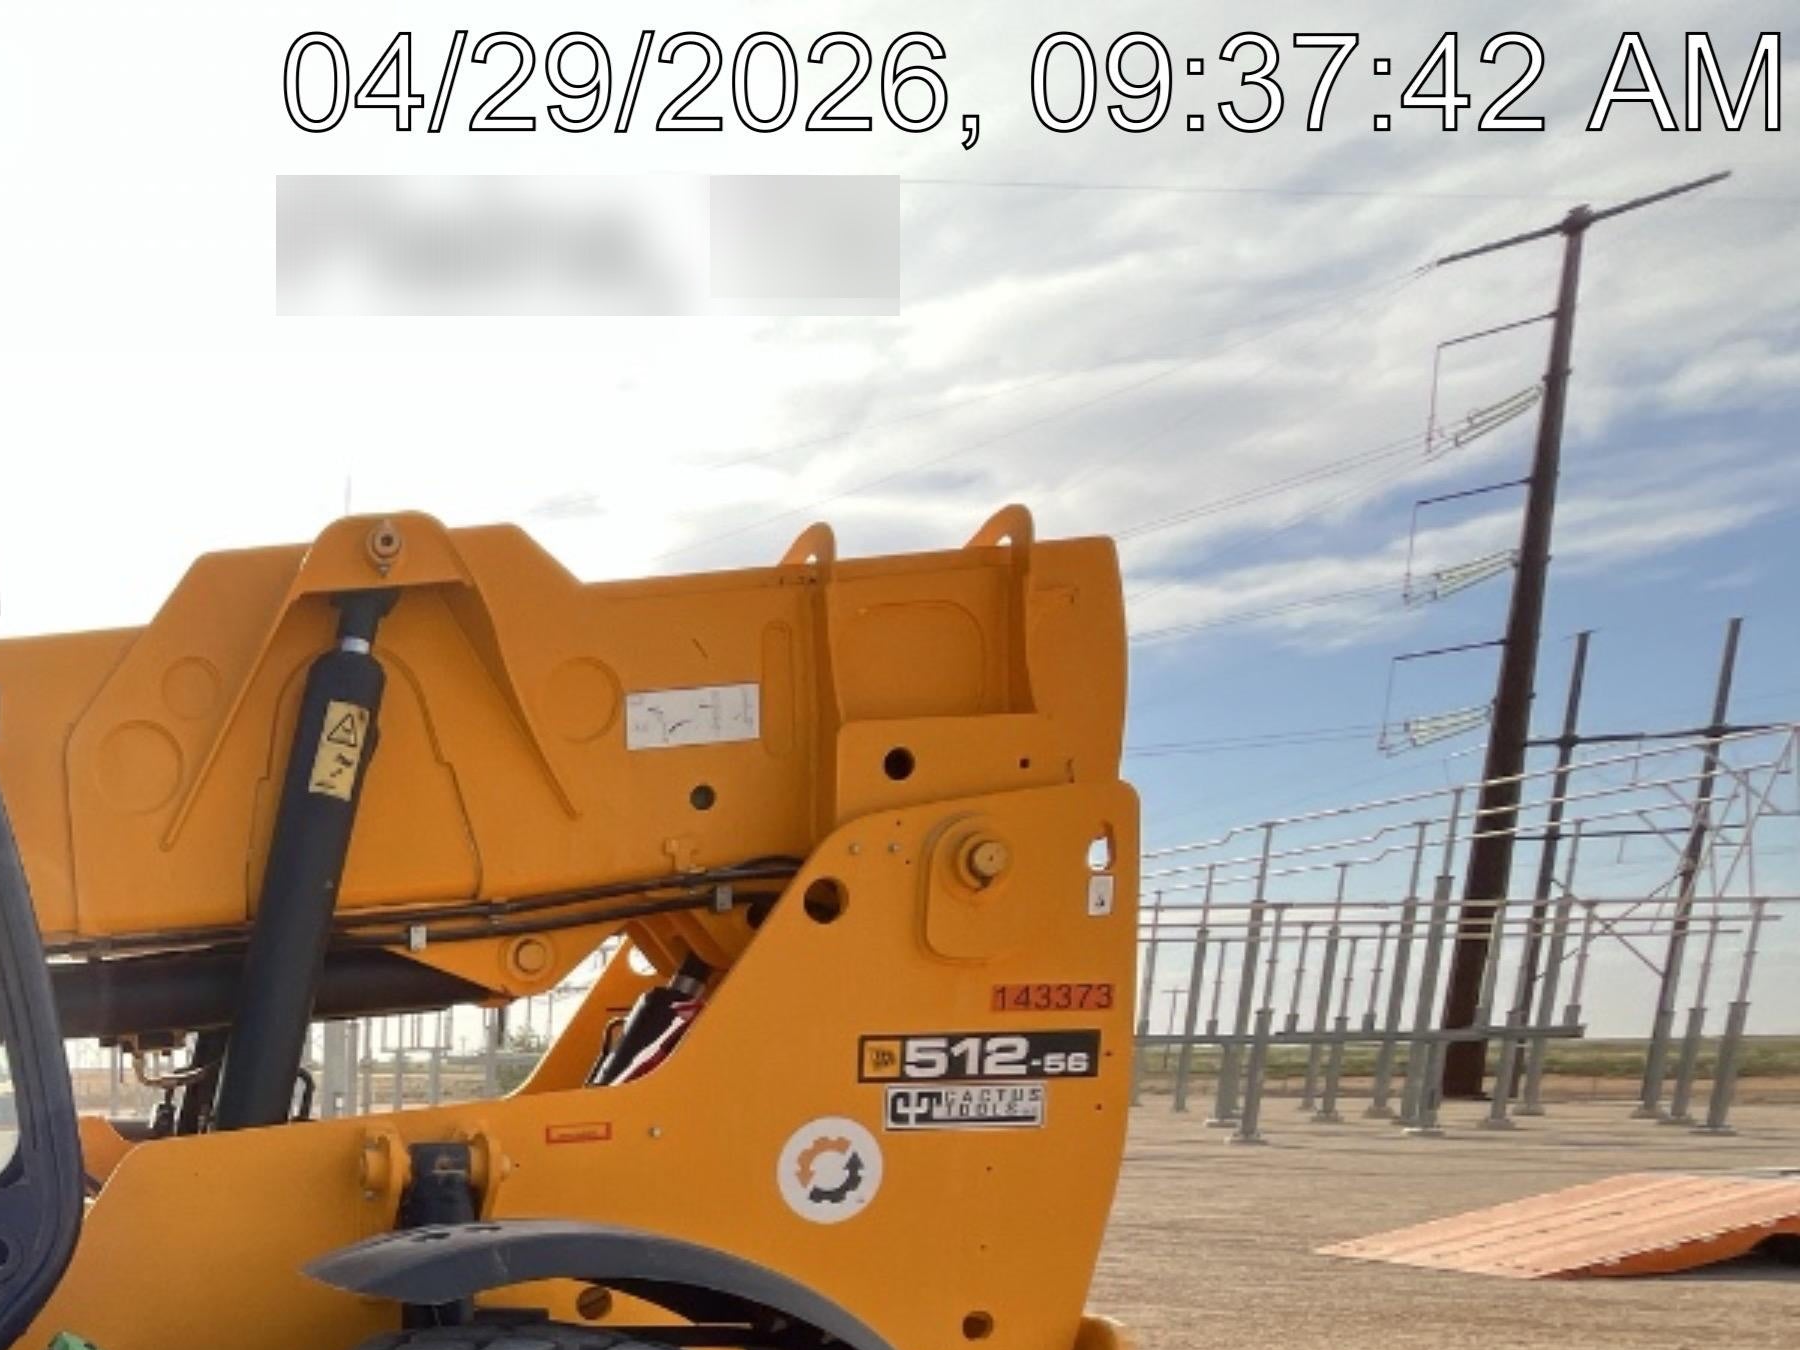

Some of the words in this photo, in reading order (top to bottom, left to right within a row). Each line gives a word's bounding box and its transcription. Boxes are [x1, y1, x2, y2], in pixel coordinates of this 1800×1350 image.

[995, 983, 1114, 1010] 143373
[903, 1036, 1090, 1079] 512-56
[944, 1087, 1042, 1105] CACTUS
